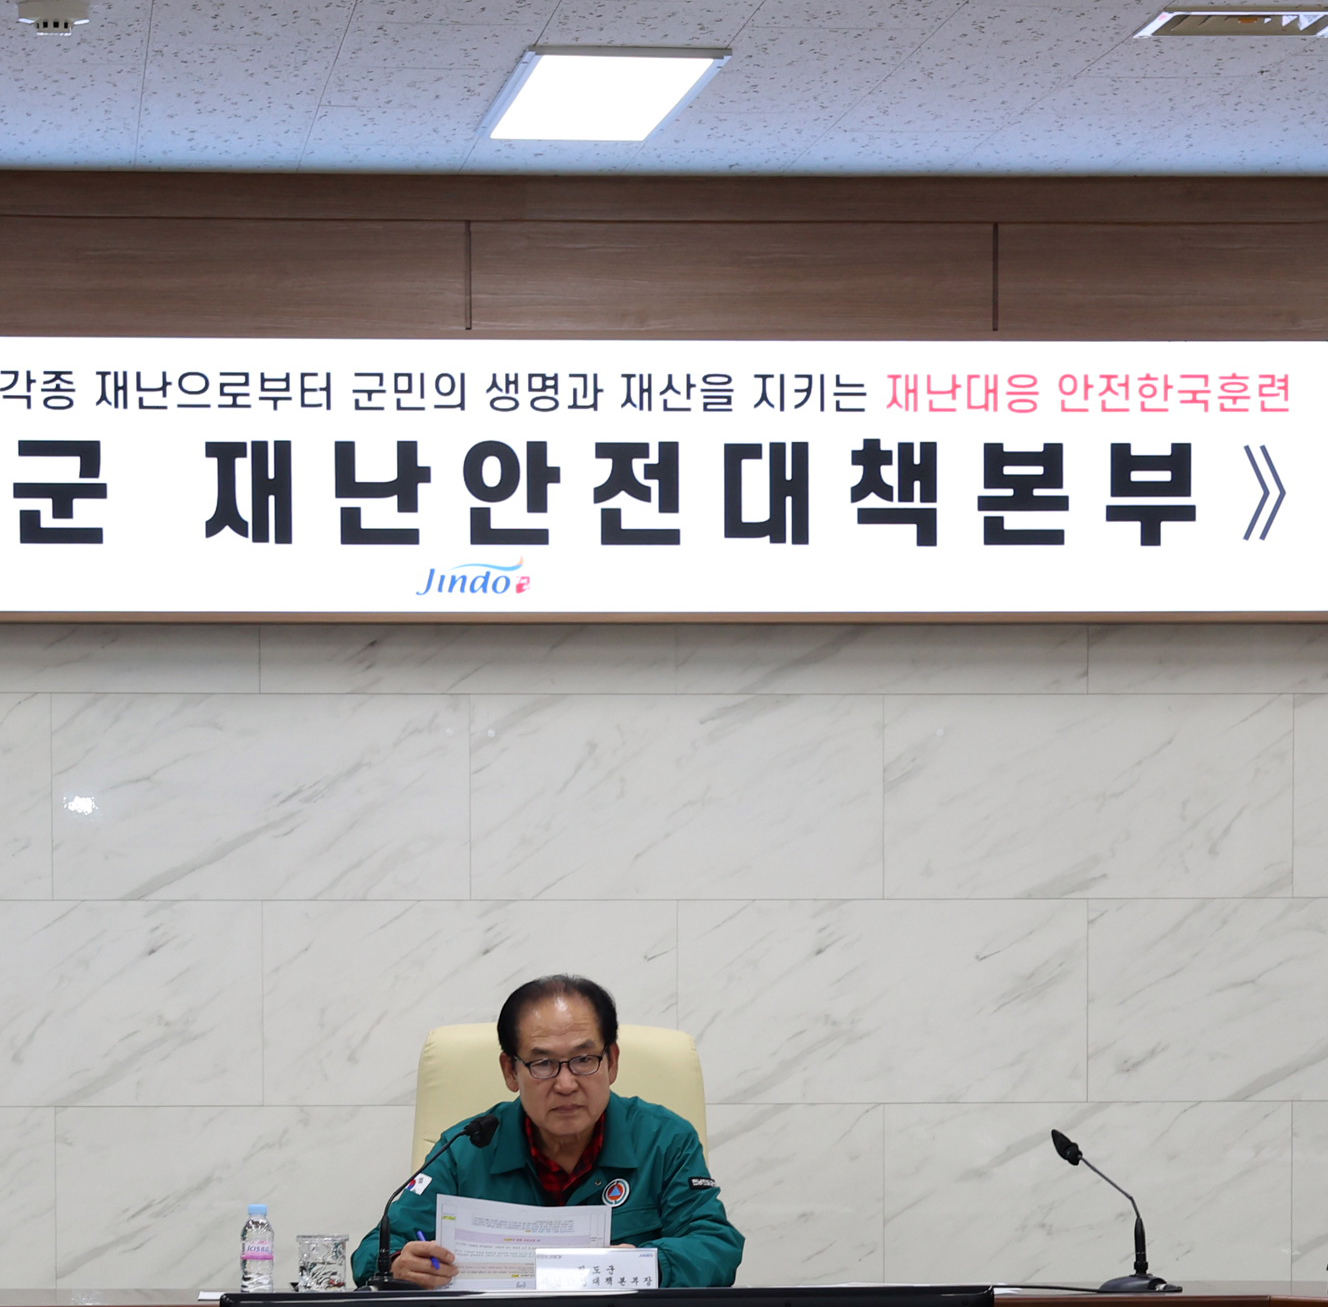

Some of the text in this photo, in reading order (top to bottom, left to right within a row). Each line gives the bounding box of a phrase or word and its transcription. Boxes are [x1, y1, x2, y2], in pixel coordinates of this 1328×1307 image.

[0, 369, 1291, 414] 각종 재난으로부터 군민의 생명과 재산을 지키는 재난대응 안전한국훈련
[416, 568, 511, 596] Jindo
